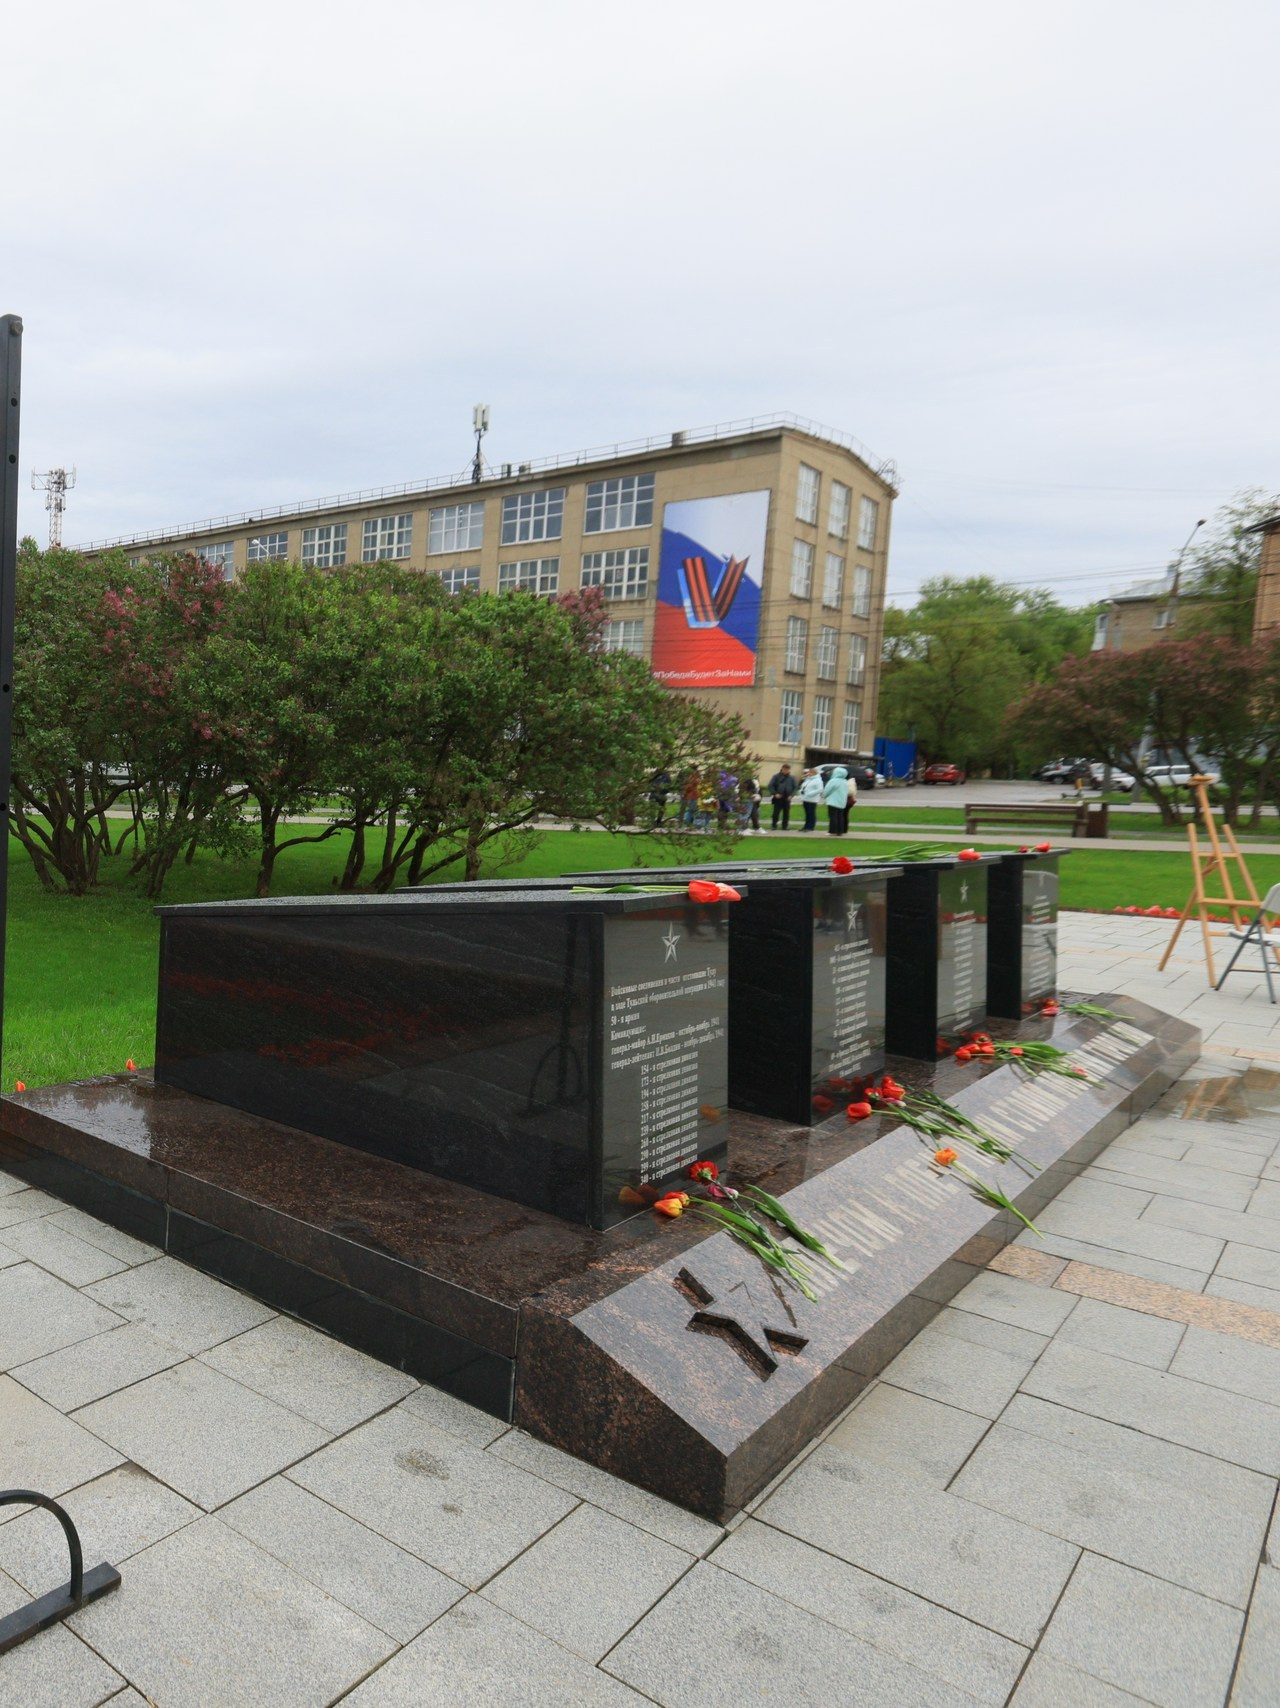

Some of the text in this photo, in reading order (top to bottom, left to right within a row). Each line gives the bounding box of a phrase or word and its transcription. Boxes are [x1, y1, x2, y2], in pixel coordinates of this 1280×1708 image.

[626, 994, 648, 1009] Тульской
[611, 1016, 617, 1026] 50
[612, 1039, 646, 1055] генерал-майор
[612, 1051, 654, 1069] генерал-лейтенант
[641, 1064, 649, 1075] 154
[989, 1081, 1069, 1132] СТОЯЛИ
